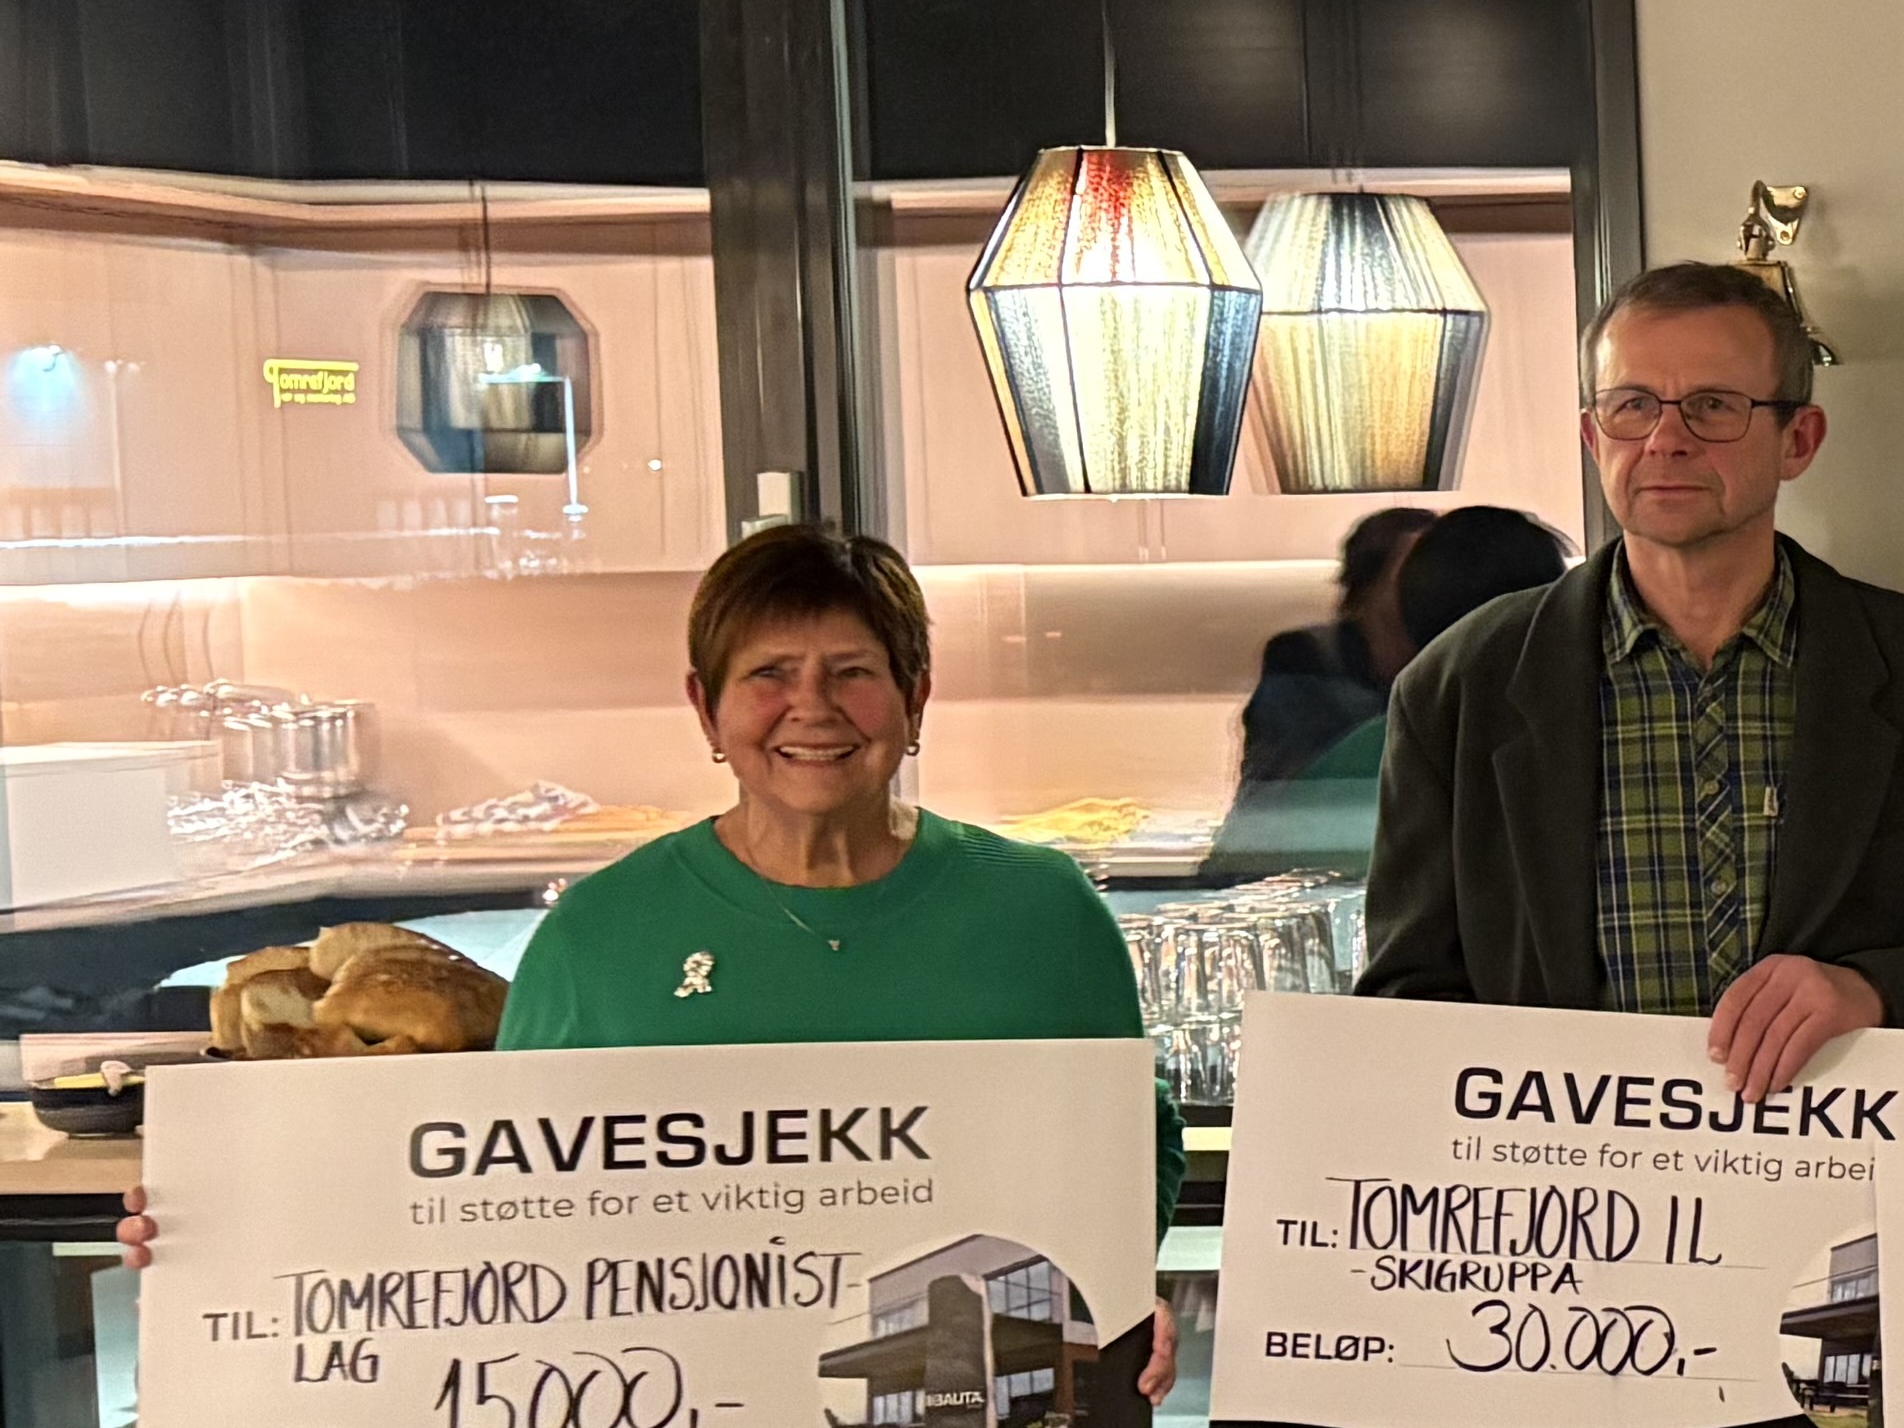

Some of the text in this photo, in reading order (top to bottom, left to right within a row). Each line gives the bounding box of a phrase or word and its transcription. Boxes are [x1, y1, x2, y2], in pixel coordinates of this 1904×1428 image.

[1453, 1066, 1899, 1142] GAVESJEKK
[410, 1105, 931, 1179] GAVESJEKK
[1451, 1135, 1876, 1183] til støtte for et viktig arbei
[409, 1177, 933, 1226] til støtte for et viktig arbeid
[1276, 1177, 1723, 1266] TIL: TOMREFJORD IL
[201, 1310, 280, 1342] TIL:
[274, 1268, 568, 1340] TOMREFJORD
[293, 1337, 380, 1384] LAG
[1265, 1331, 1395, 1364] BELØP:
